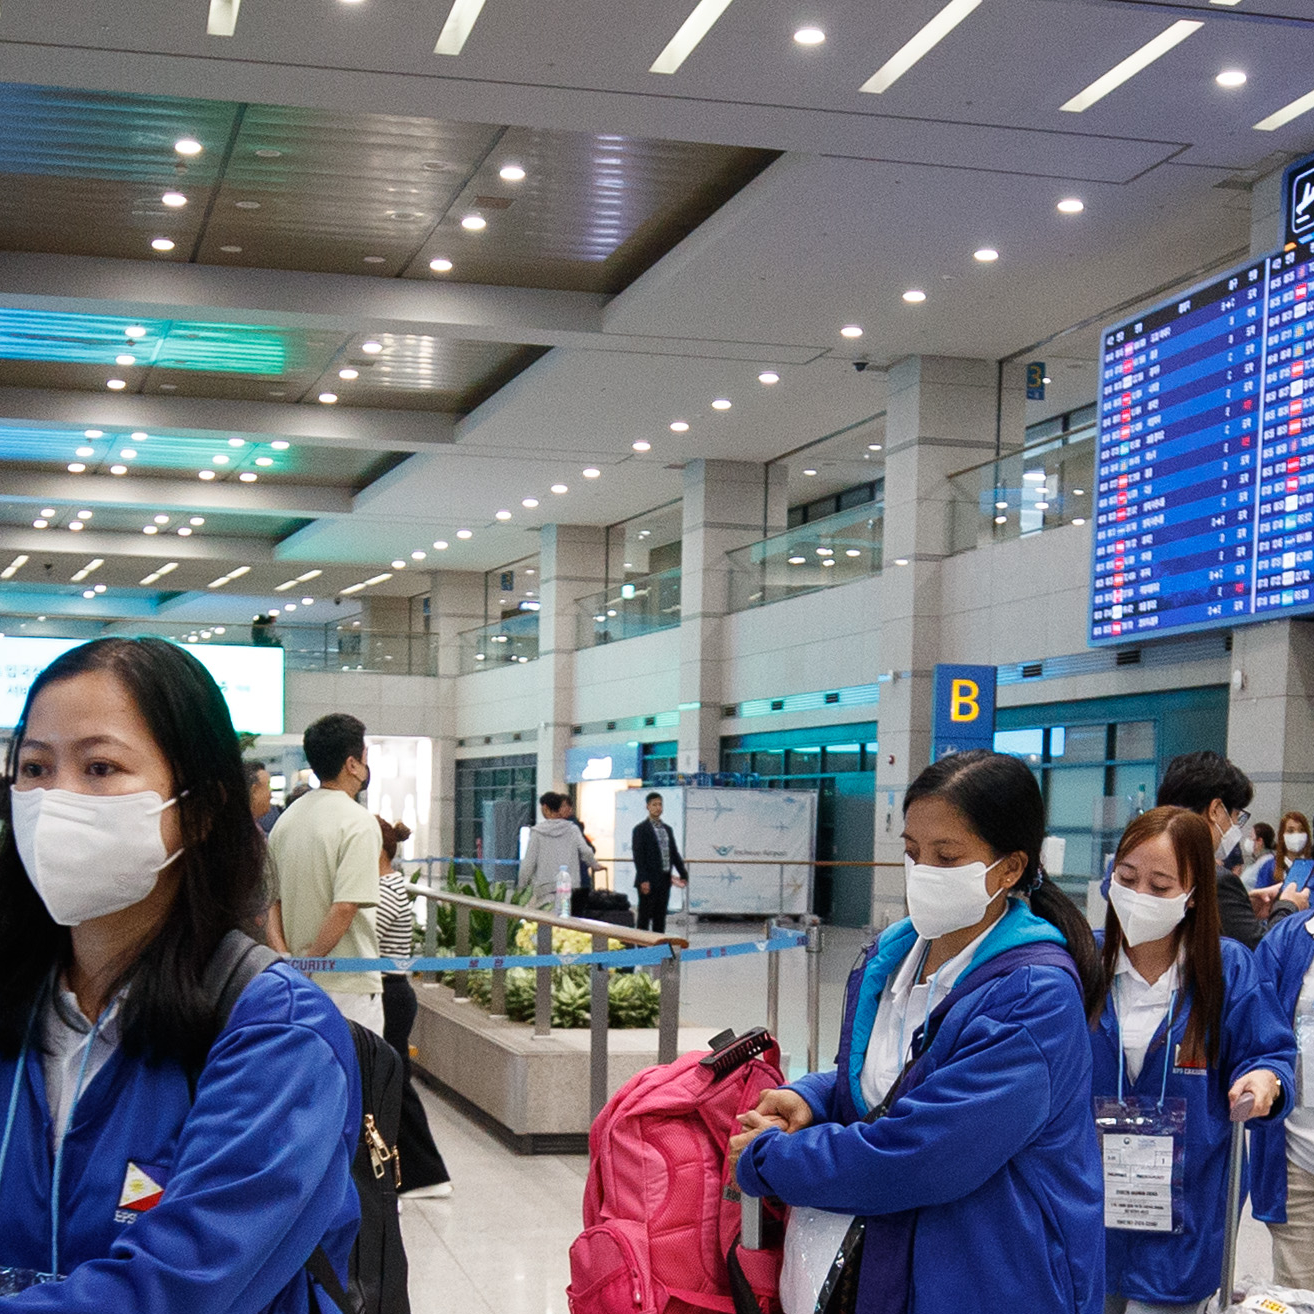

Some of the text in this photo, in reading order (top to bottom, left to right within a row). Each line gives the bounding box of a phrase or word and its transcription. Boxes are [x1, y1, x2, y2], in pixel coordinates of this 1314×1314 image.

[1028, 366, 1041, 387] 3
[950, 679, 980, 723] B
[114, 1210, 138, 1224] EPS
